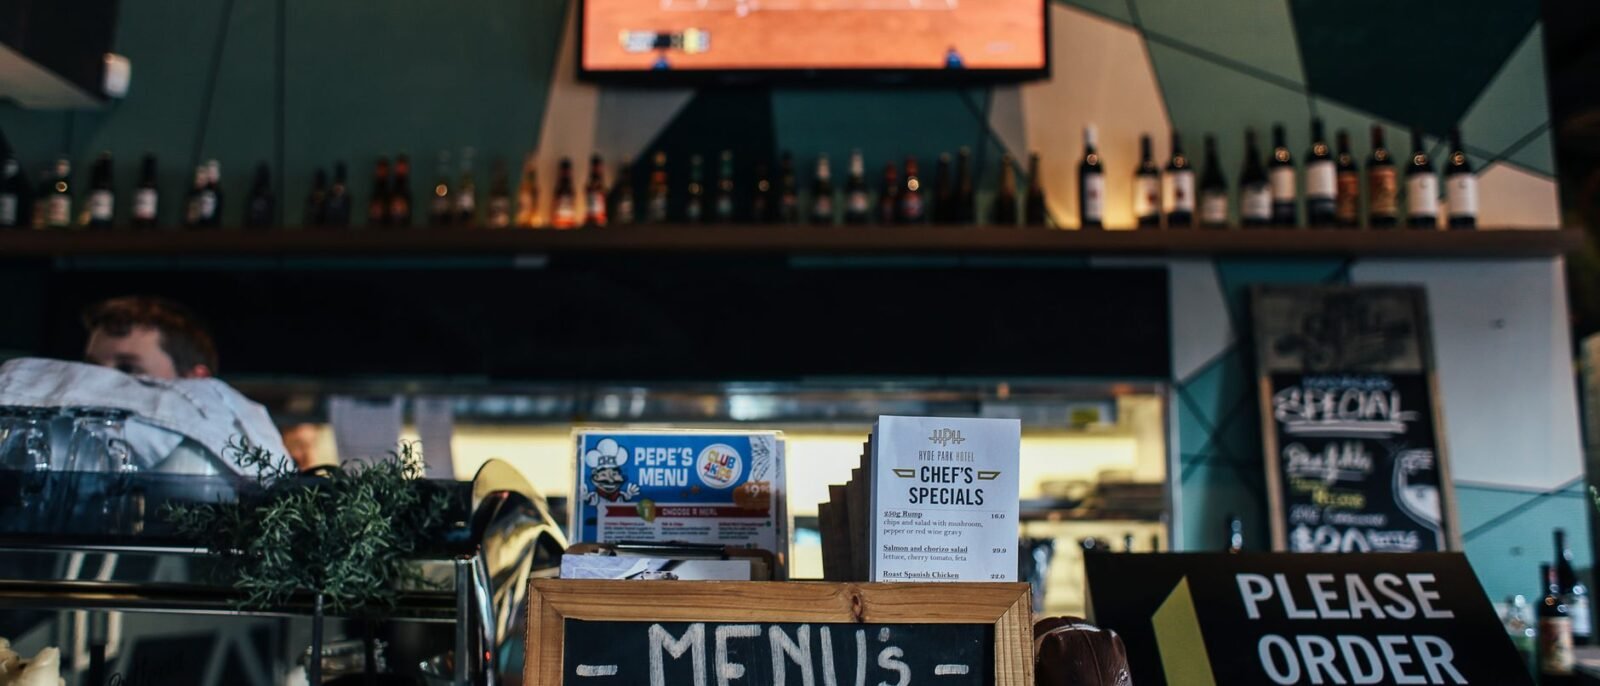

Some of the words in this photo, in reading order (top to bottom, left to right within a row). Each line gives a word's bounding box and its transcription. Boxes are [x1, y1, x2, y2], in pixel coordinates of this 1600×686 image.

[634, 447, 693, 466] PEPE'S
[708, 450, 737, 469] CLUB
[919, 450, 935, 461] HYDE
[937, 451, 954, 461] PARK
[955, 451, 975, 462] HOTEL
[638, 468, 689, 486] MENU
[920, 466, 973, 484] CHEF'S
[908, 487, 984, 506] SPECIALS
[662, 507, 690, 516] CHOOSE
[883, 511, 901, 519] 250g
[902, 511, 923, 519] Rump
[948, 520, 984, 528] mushroom,
[944, 529, 962, 537] gravy
[883, 544, 909, 552] Salmon
[907, 554, 928, 562] cherry
[904, 571, 930, 579] Spanish
[931, 571, 960, 579] Chicken
[1235, 573, 1454, 619] PLEASE
[1258, 634, 1468, 686] ORDER
